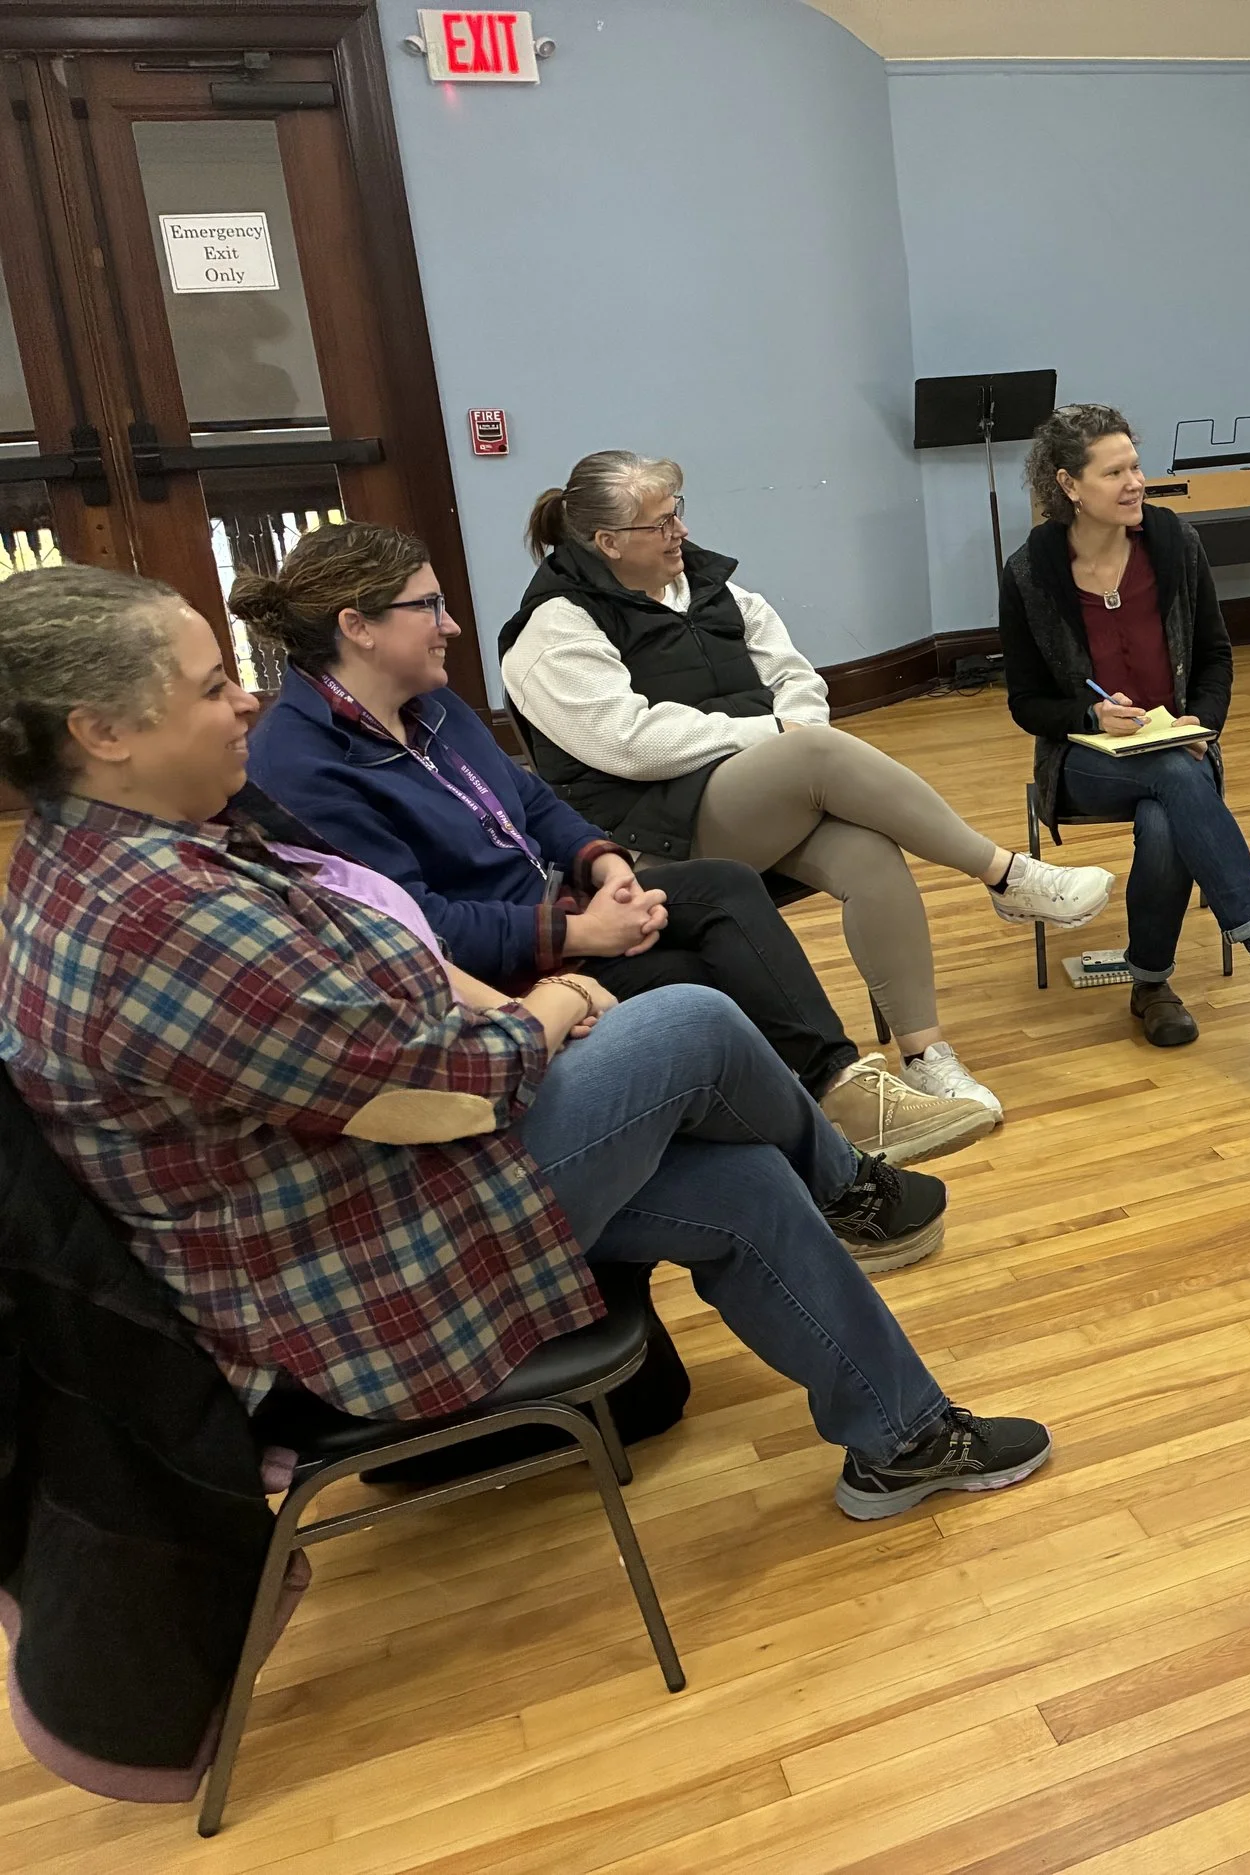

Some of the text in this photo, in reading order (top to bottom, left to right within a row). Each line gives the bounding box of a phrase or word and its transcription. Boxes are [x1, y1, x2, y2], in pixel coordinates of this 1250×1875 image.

[442, 13, 519, 74] EXIT
[170, 224, 262, 240] Emergency
[204, 246, 240, 260] Exit
[205, 268, 245, 284] Only
[474, 411, 501, 421] FIRE
